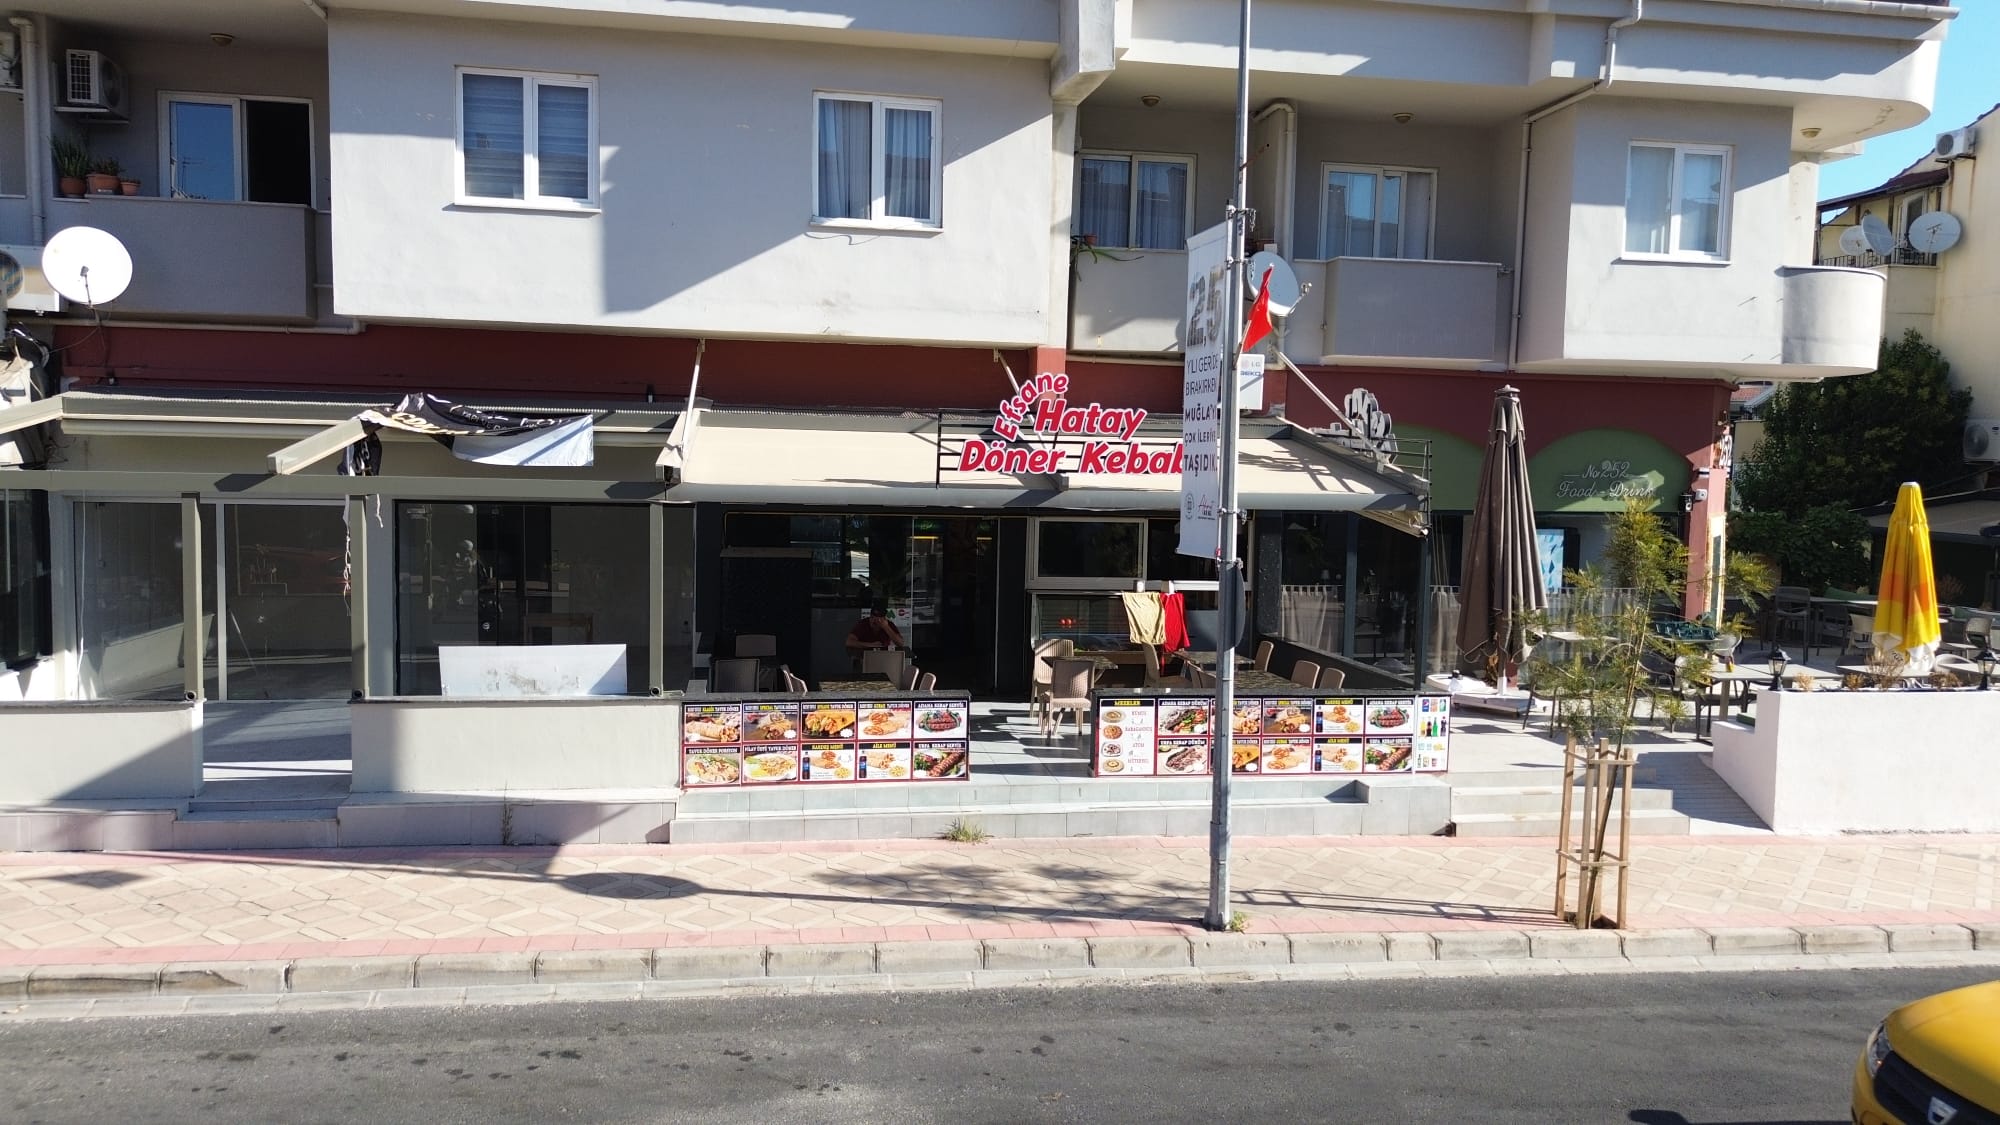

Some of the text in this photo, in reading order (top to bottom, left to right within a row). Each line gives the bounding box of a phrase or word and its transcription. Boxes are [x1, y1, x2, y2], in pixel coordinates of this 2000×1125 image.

[993, 373, 1068, 441] Efsane
[1034, 398, 1147, 443] Hatay
[959, 440, 1066, 474] Döner
[1556, 480, 1598, 498] Food
